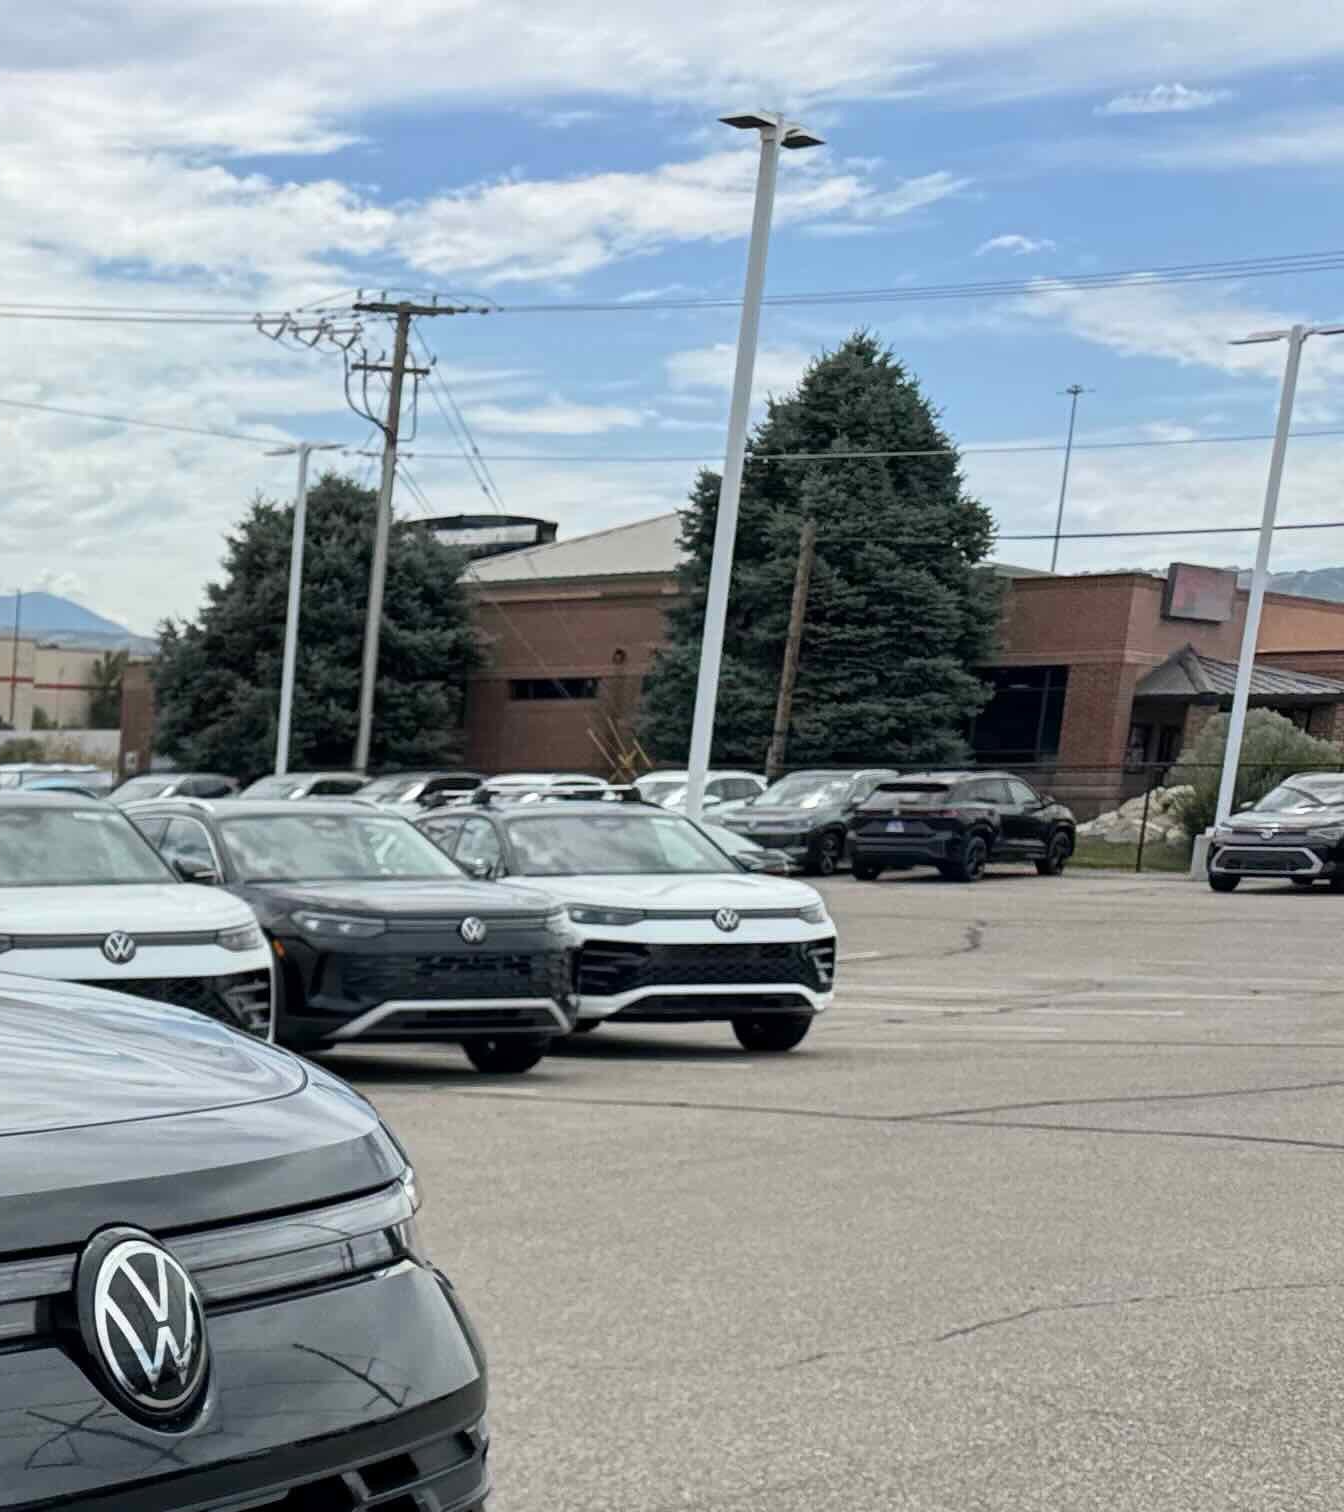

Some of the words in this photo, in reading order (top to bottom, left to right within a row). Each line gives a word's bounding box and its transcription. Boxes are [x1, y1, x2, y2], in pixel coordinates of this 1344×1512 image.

[461, 916, 486, 942] VW
[715, 907, 739, 931] VW
[104, 931, 137, 964] VW
[95, 1240, 202, 1409] VW
